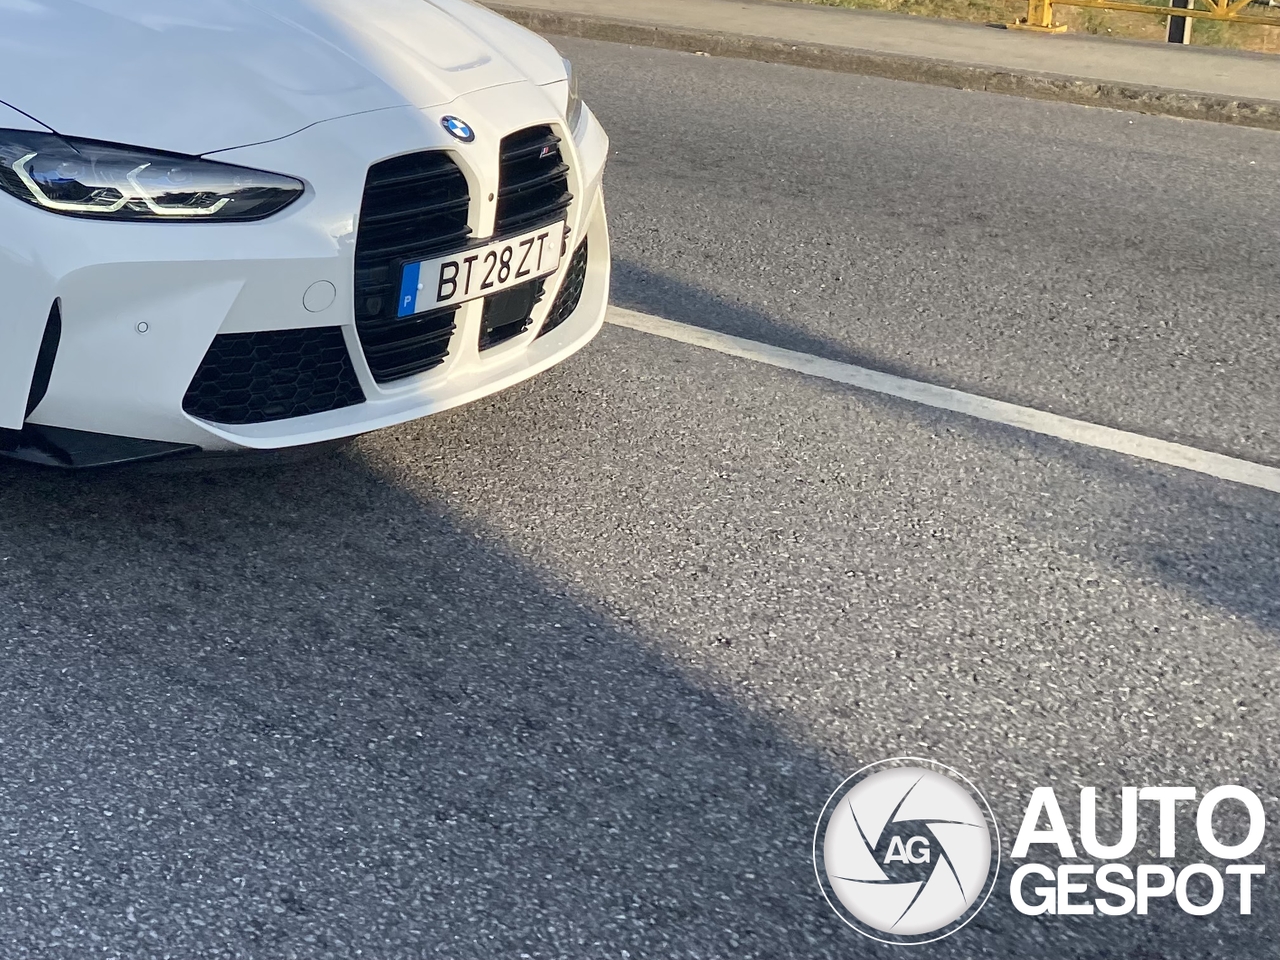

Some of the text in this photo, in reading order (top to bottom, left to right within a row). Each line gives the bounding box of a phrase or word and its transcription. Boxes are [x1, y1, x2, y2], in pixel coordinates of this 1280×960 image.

[436, 232, 550, 302] BT 28 ZT
[403, 295, 412, 308] P
